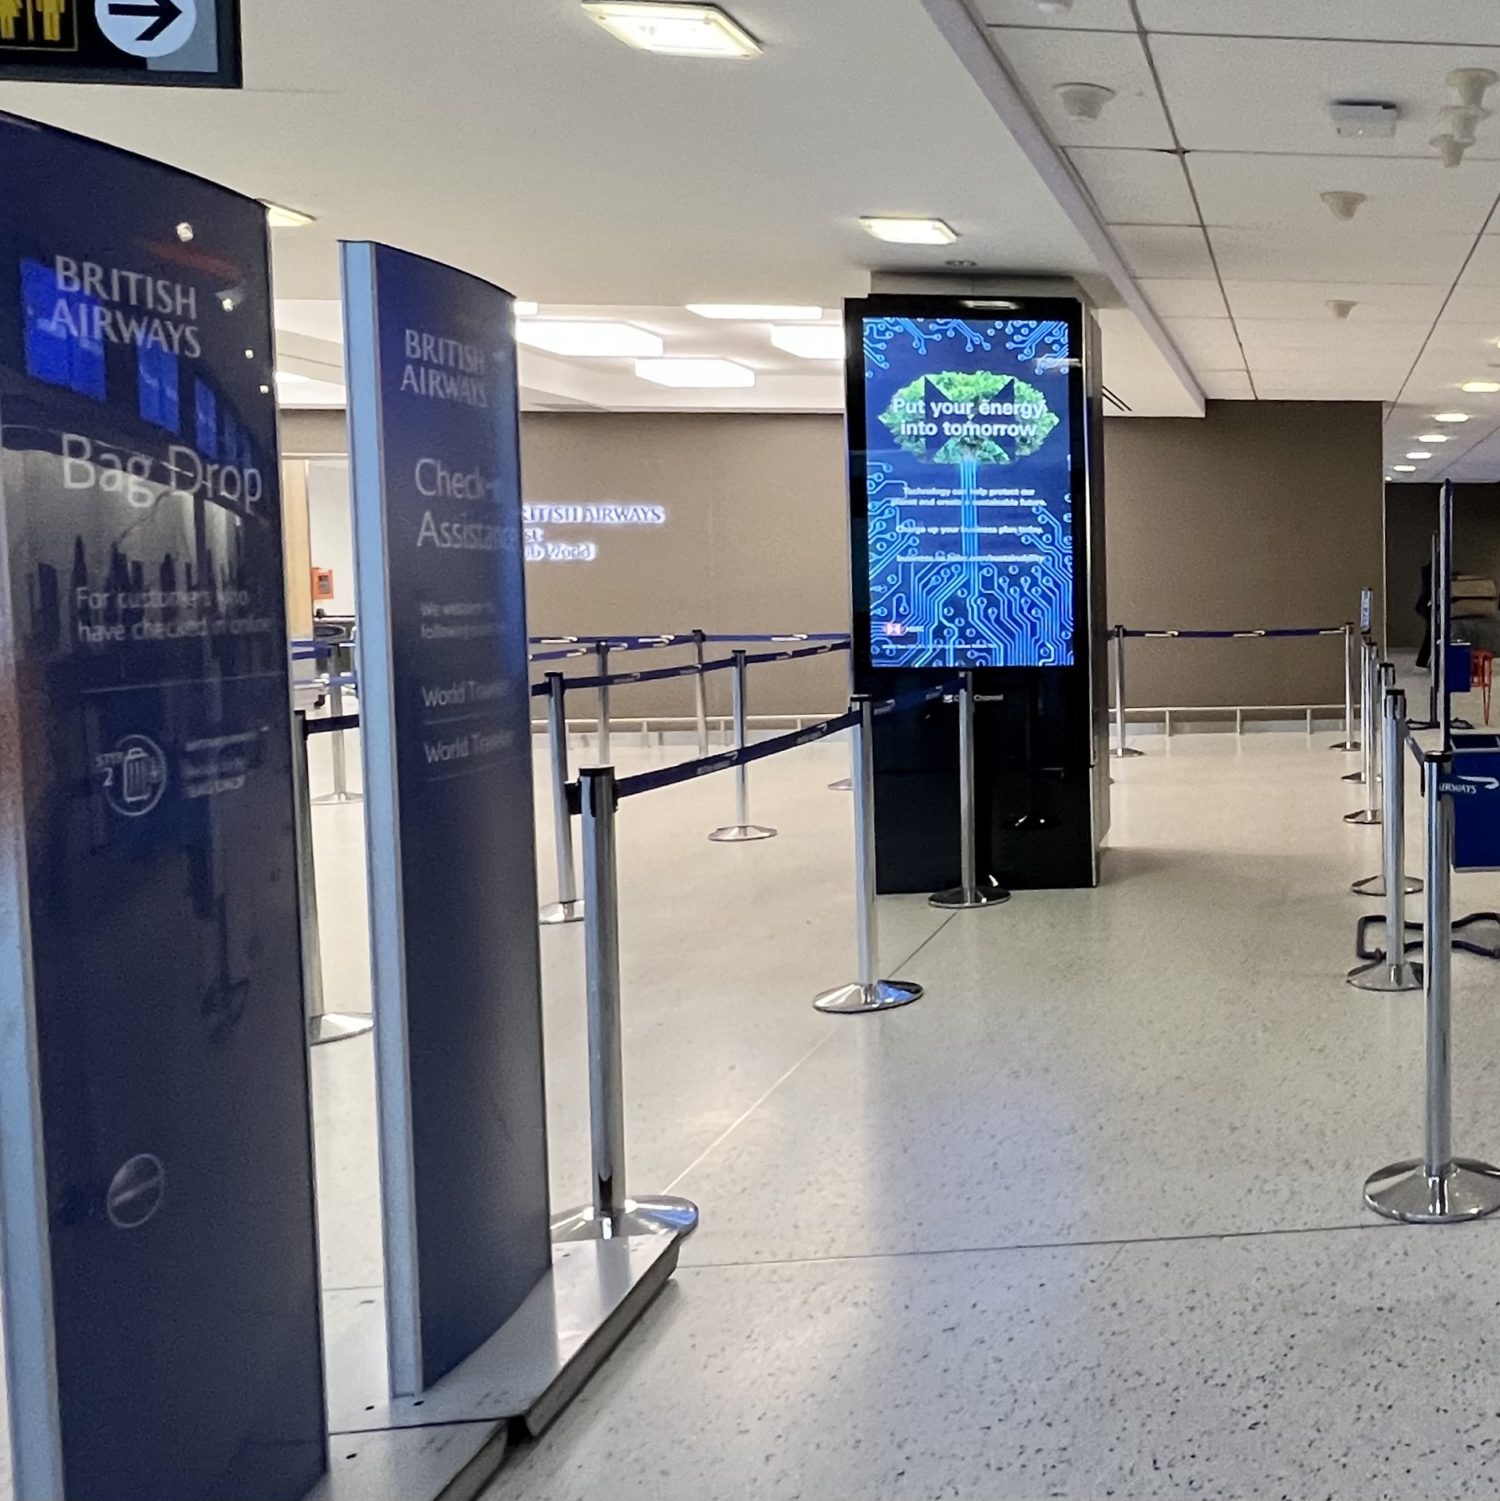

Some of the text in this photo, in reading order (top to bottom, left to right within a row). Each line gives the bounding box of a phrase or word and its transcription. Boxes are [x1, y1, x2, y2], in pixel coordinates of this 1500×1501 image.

[55, 254, 197, 320] BRITISH
[50, 298, 201, 358] AIRWAYS
[405, 328, 486, 376] BRITISH
[401, 364, 489, 408] AIRWAYS
[892, 399, 1045, 419] Put your energy
[900, 420, 1038, 437] into tomorrow
[62, 433, 263, 515] Bag Drop
[583, 506, 662, 522] AIRWAYS
[76, 586, 110, 609] For
[78, 622, 125, 643] have
[420, 680, 466, 708] World
[423, 735, 470, 765] World
[101, 767, 115, 787] 2
